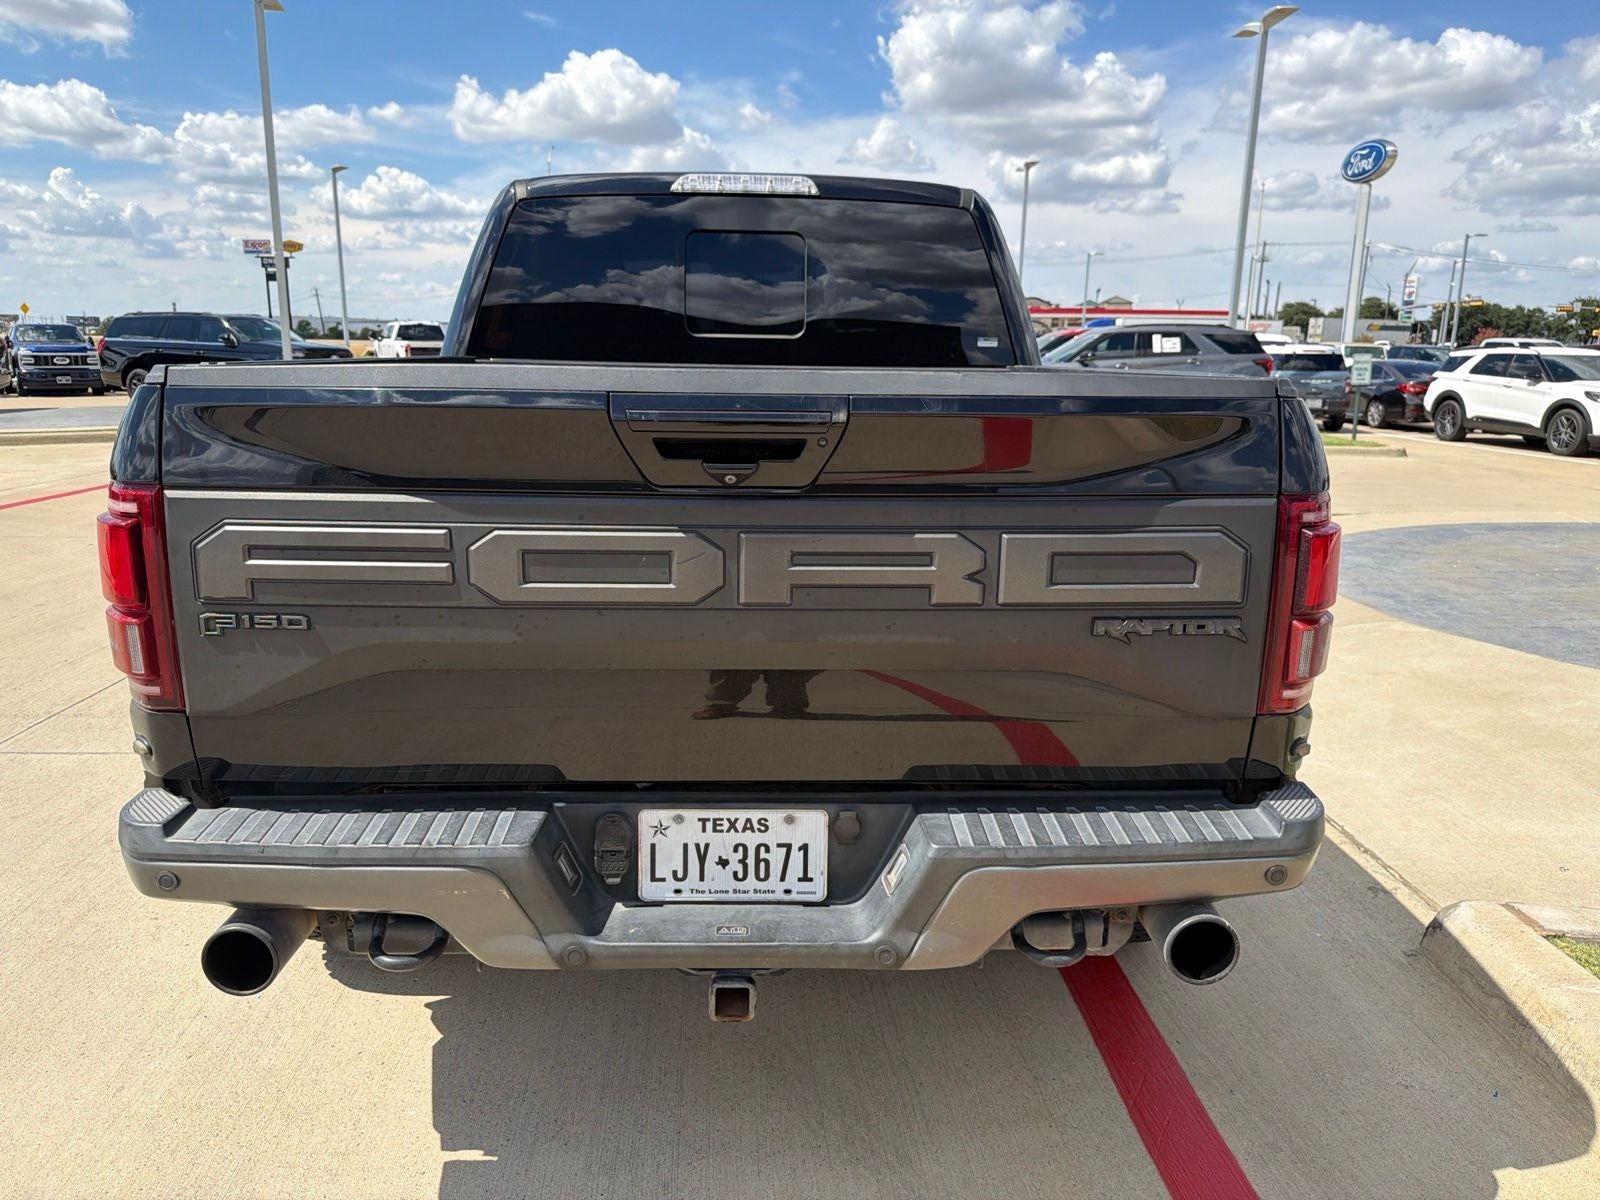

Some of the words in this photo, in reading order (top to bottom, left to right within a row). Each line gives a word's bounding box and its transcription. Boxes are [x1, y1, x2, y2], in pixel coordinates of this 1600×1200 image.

[1347, 148, 1376, 176] Ford
[244, 240, 269, 250] Exxon
[193, 522, 1248, 607] FORD
[1091, 617, 1247, 645] RAPTOR
[698, 817, 770, 834] TEXAS
[649, 842, 710, 883] LJY
[732, 842, 814, 883] 3671
